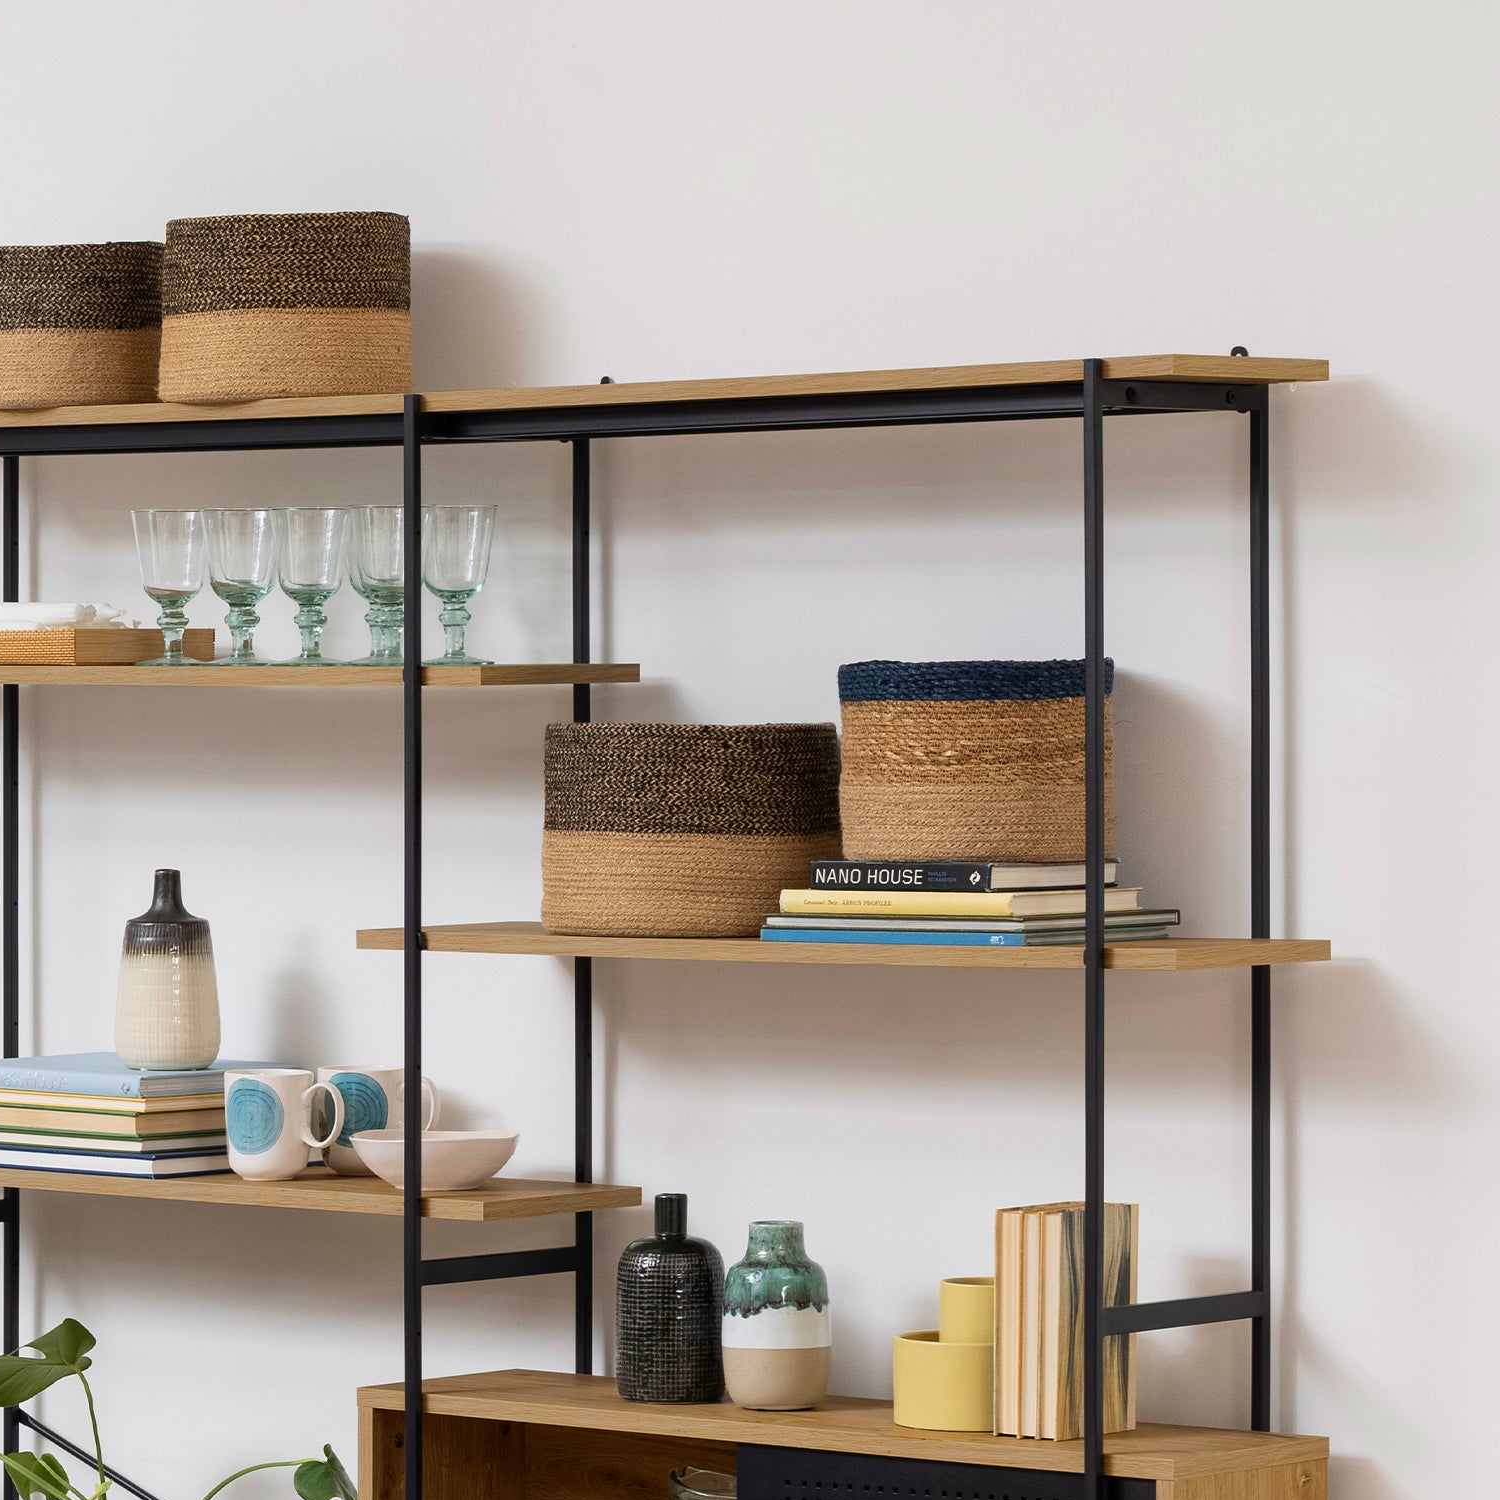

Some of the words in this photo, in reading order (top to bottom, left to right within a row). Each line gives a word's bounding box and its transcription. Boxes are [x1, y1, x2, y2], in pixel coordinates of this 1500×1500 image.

[815, 868, 862, 884] NANO
[867, 869, 924, 885] HOUSE
[27, 1071, 68, 1091] House
